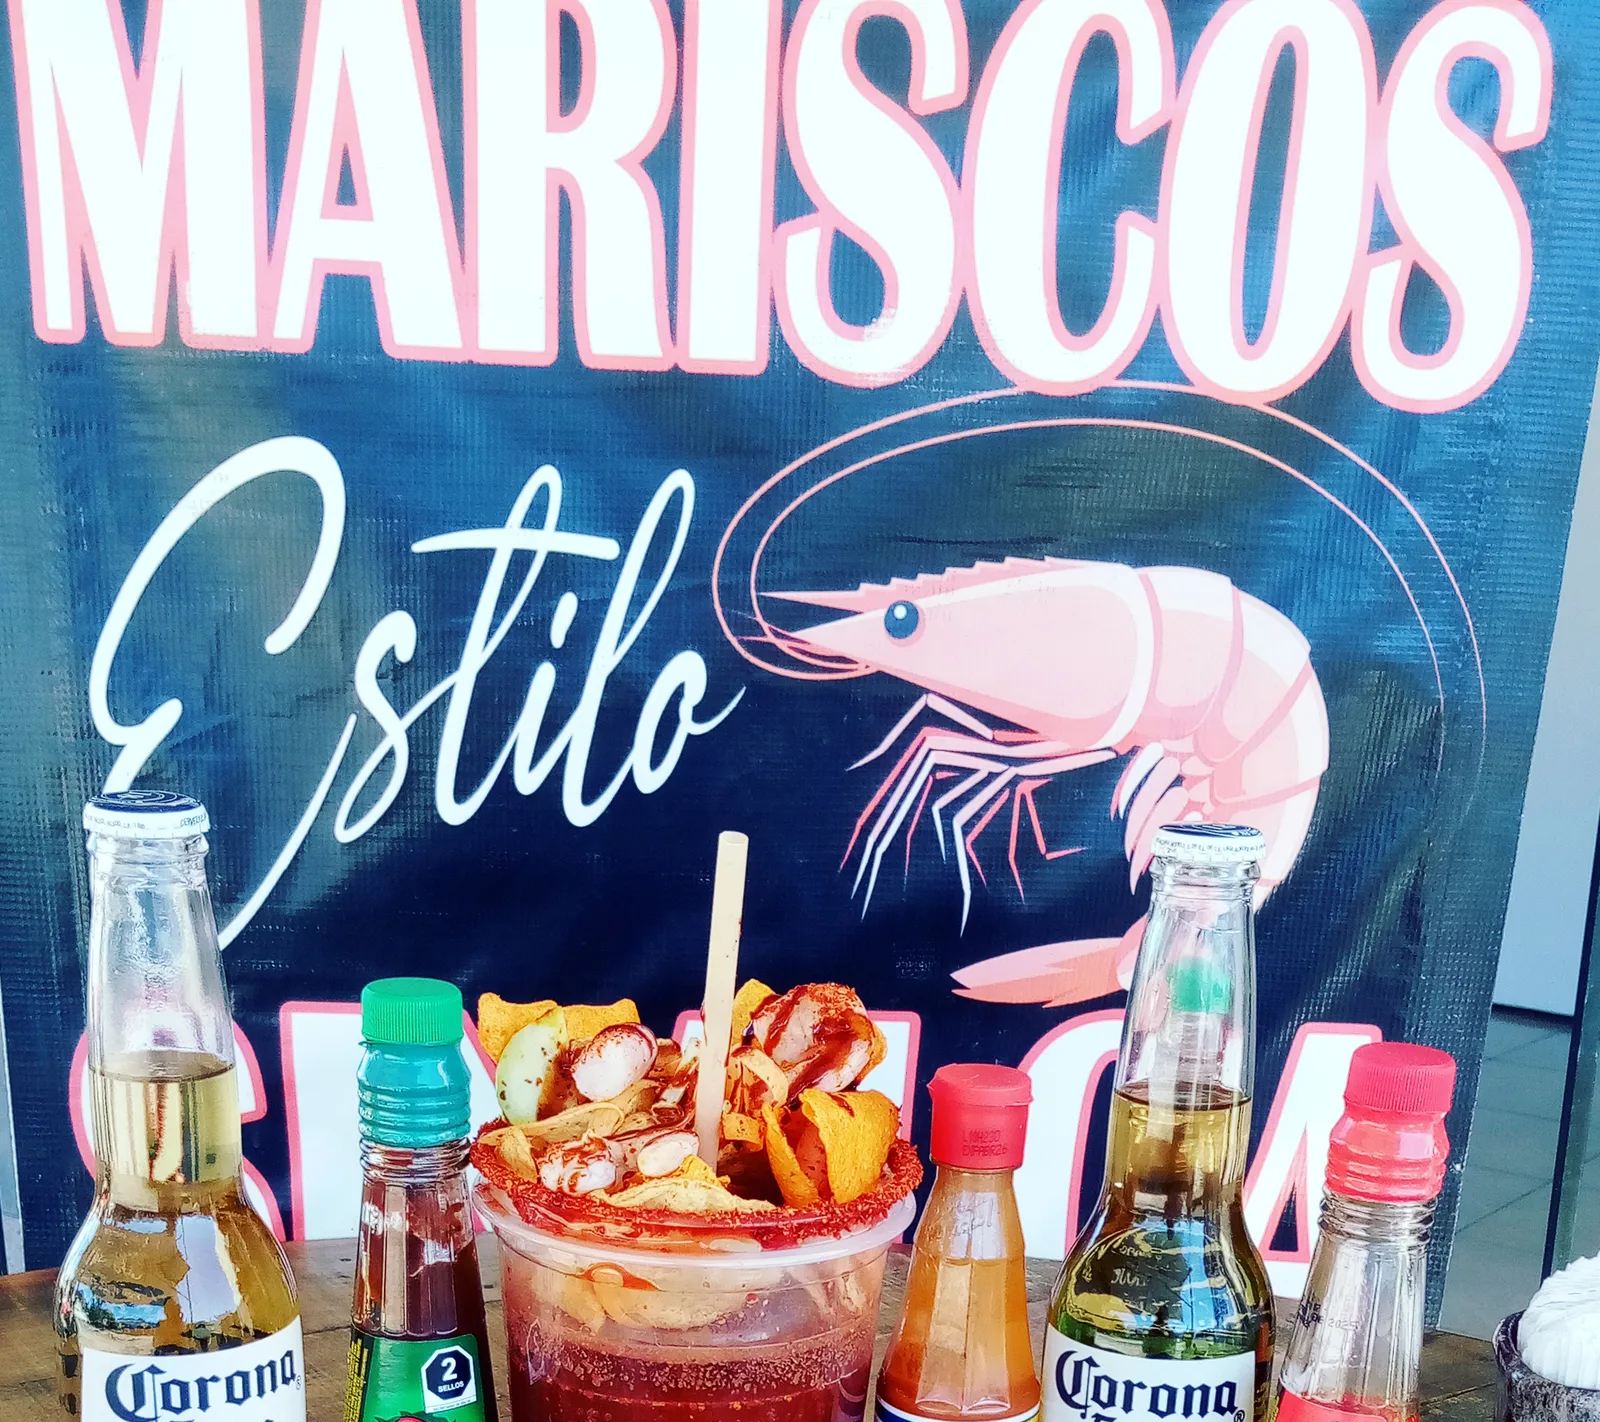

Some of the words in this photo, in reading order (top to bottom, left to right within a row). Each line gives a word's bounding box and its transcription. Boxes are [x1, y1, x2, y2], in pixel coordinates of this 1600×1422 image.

[8, 0, 1553, 413] MARISCOS
[89, 435, 747, 951] Estilo
[438, 1381, 464, 1393] SELLOS
[441, 1357, 457, 1381] 2
[1055, 1350, 1238, 1419] Corona
